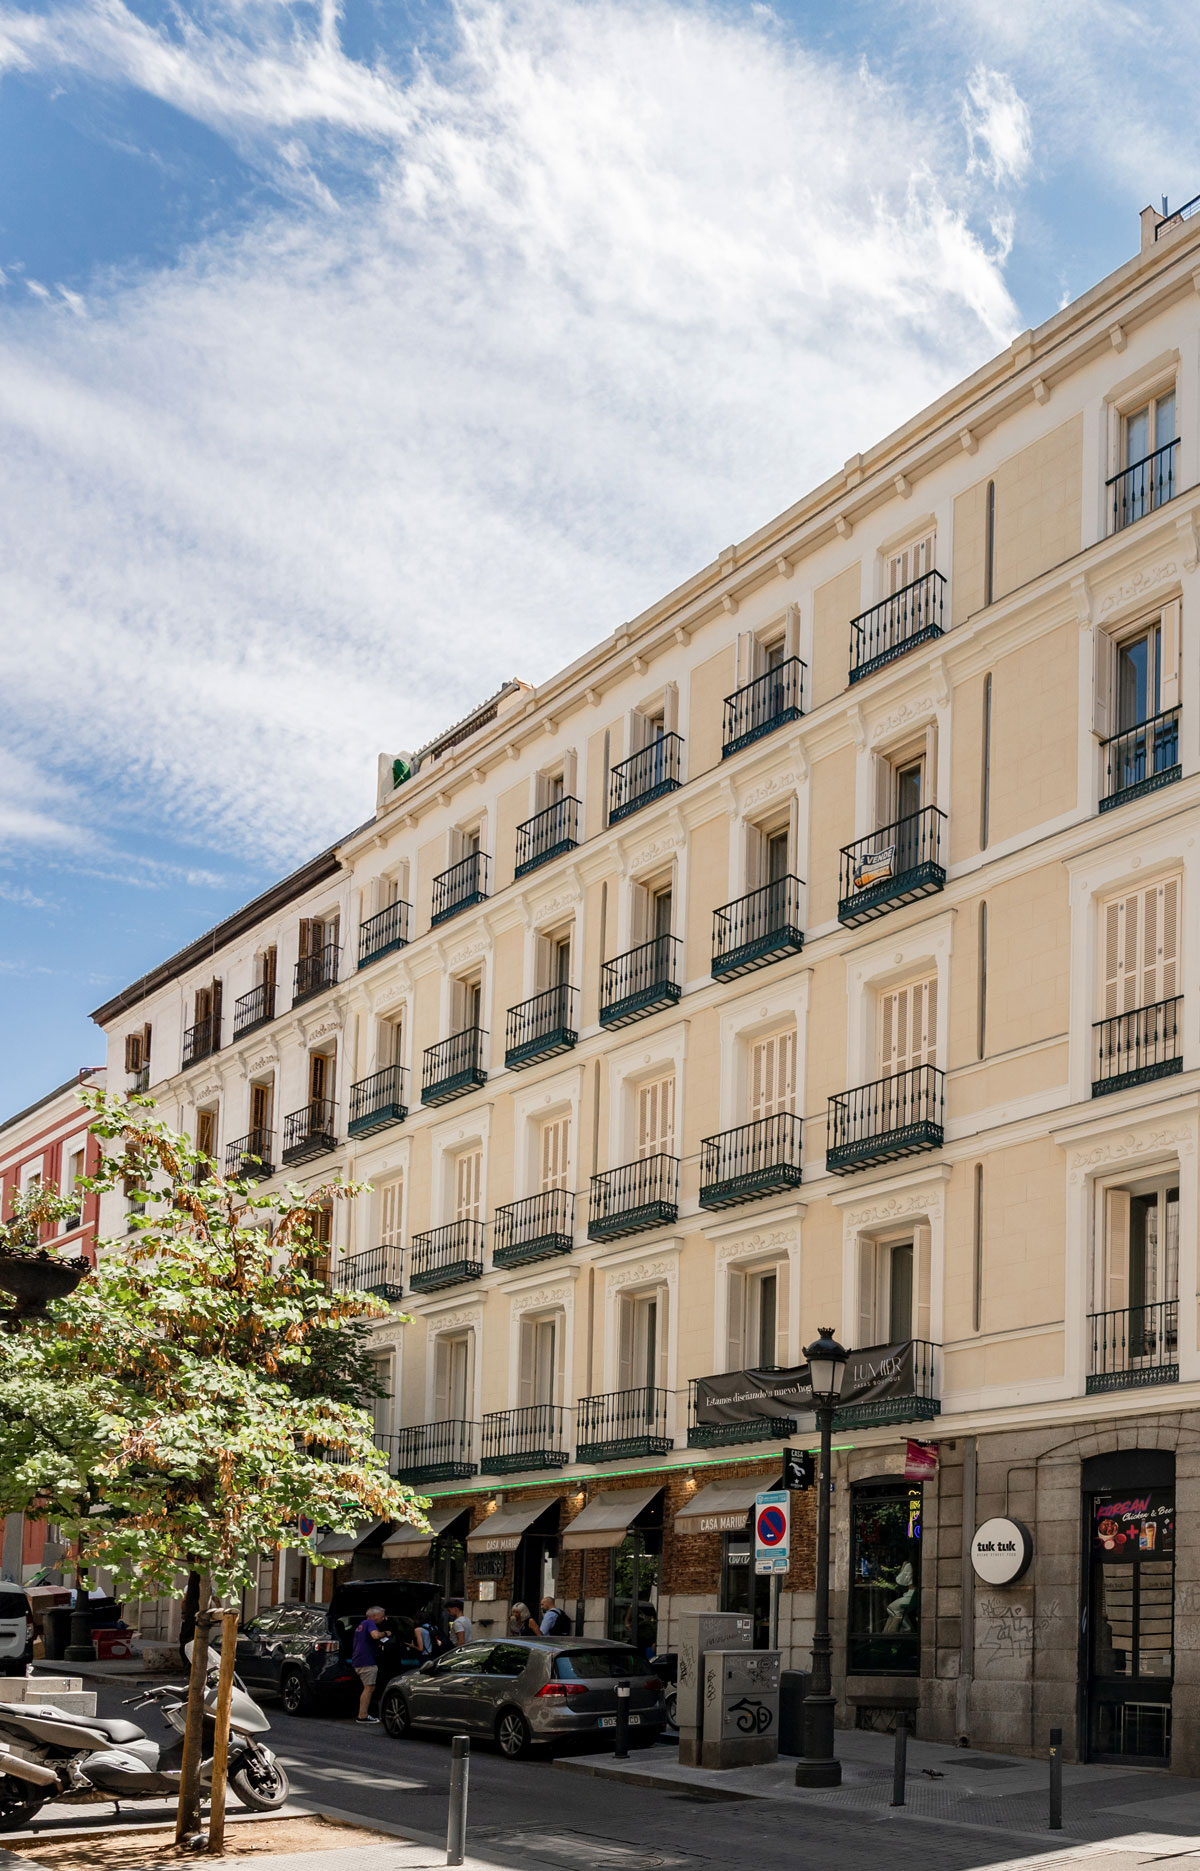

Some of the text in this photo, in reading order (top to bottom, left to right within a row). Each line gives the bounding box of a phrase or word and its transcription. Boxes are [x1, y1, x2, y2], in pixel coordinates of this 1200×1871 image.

[867, 849, 893, 864] VENDE
[853, 1381, 871, 1390] CASAS
[706, 1396, 732, 1407] Estamos
[733, 1390, 767, 1402] diseñando
[774, 1386, 797, 1397] nuevo
[797, 1382, 813, 1395] hog
[791, 1450, 804, 1458] CASA
[1096, 1494, 1152, 1520] KOREAN
[1122, 1511, 1149, 1522] Chicken
[1157, 1505, 1174, 1515] Bee
[700, 1515, 747, 1531] CASA MARIUS
[486, 1540, 500, 1551] CASA
[977, 1541, 1016, 1552] tuk tuk
